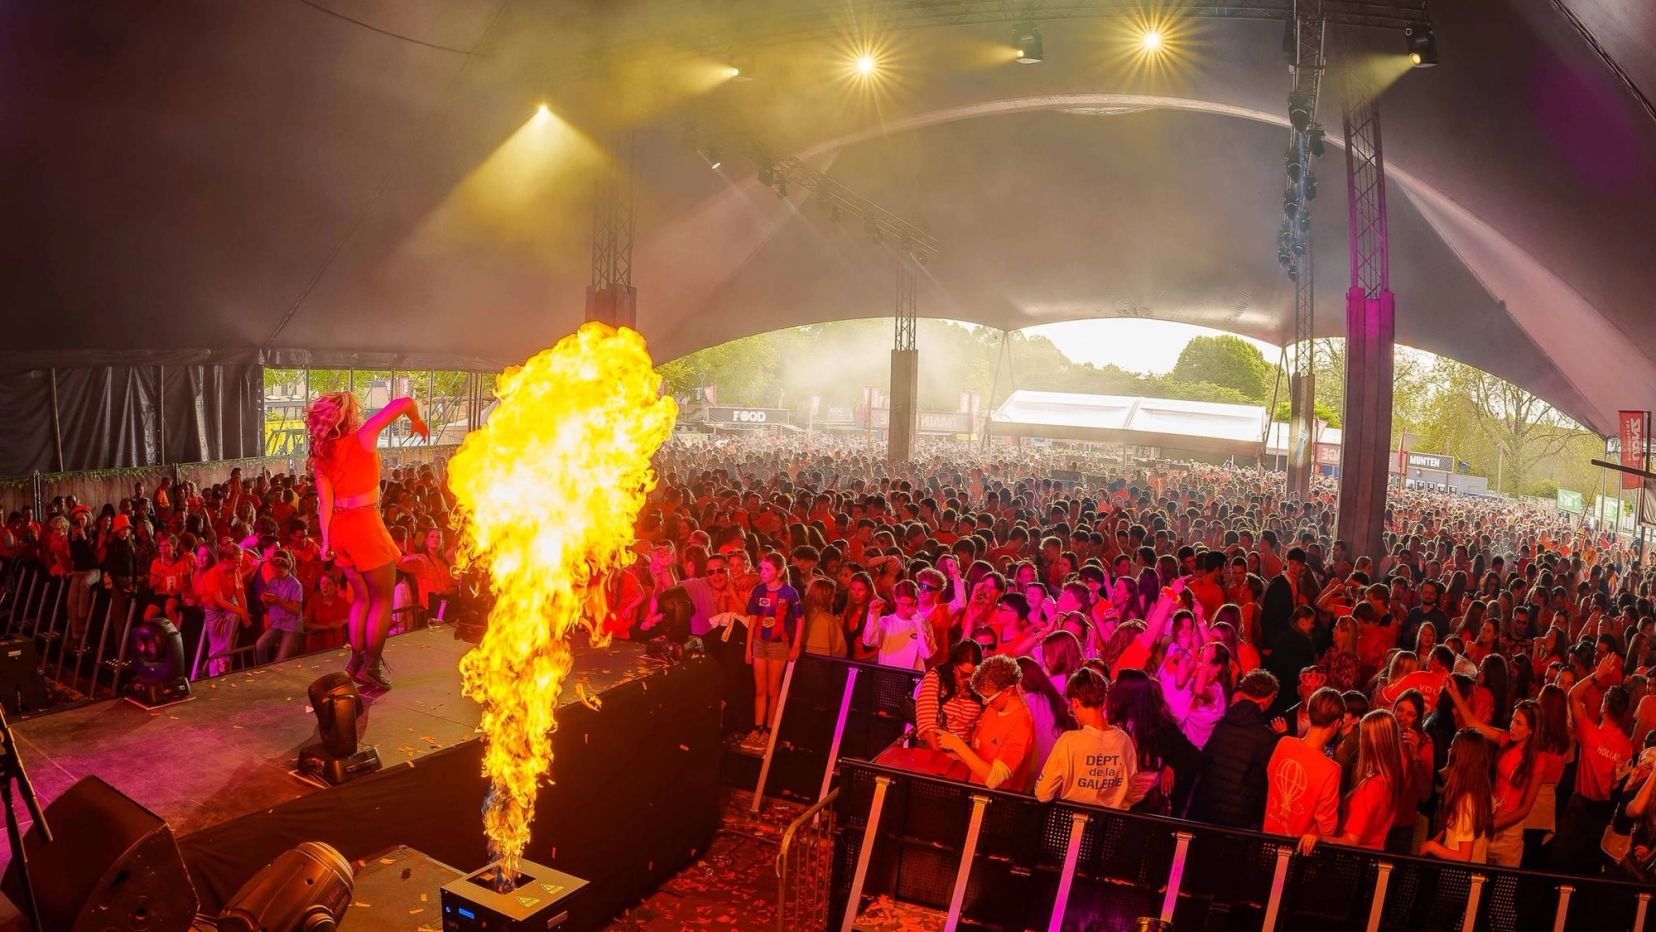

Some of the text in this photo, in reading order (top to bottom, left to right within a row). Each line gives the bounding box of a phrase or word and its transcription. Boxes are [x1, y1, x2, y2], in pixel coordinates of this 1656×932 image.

[733, 410, 766, 422] FOOD
[1409, 455, 1440, 468] MUNTEN
[1086, 753, 1122, 766] DÉPT.
[1089, 768, 1116, 777] de la
